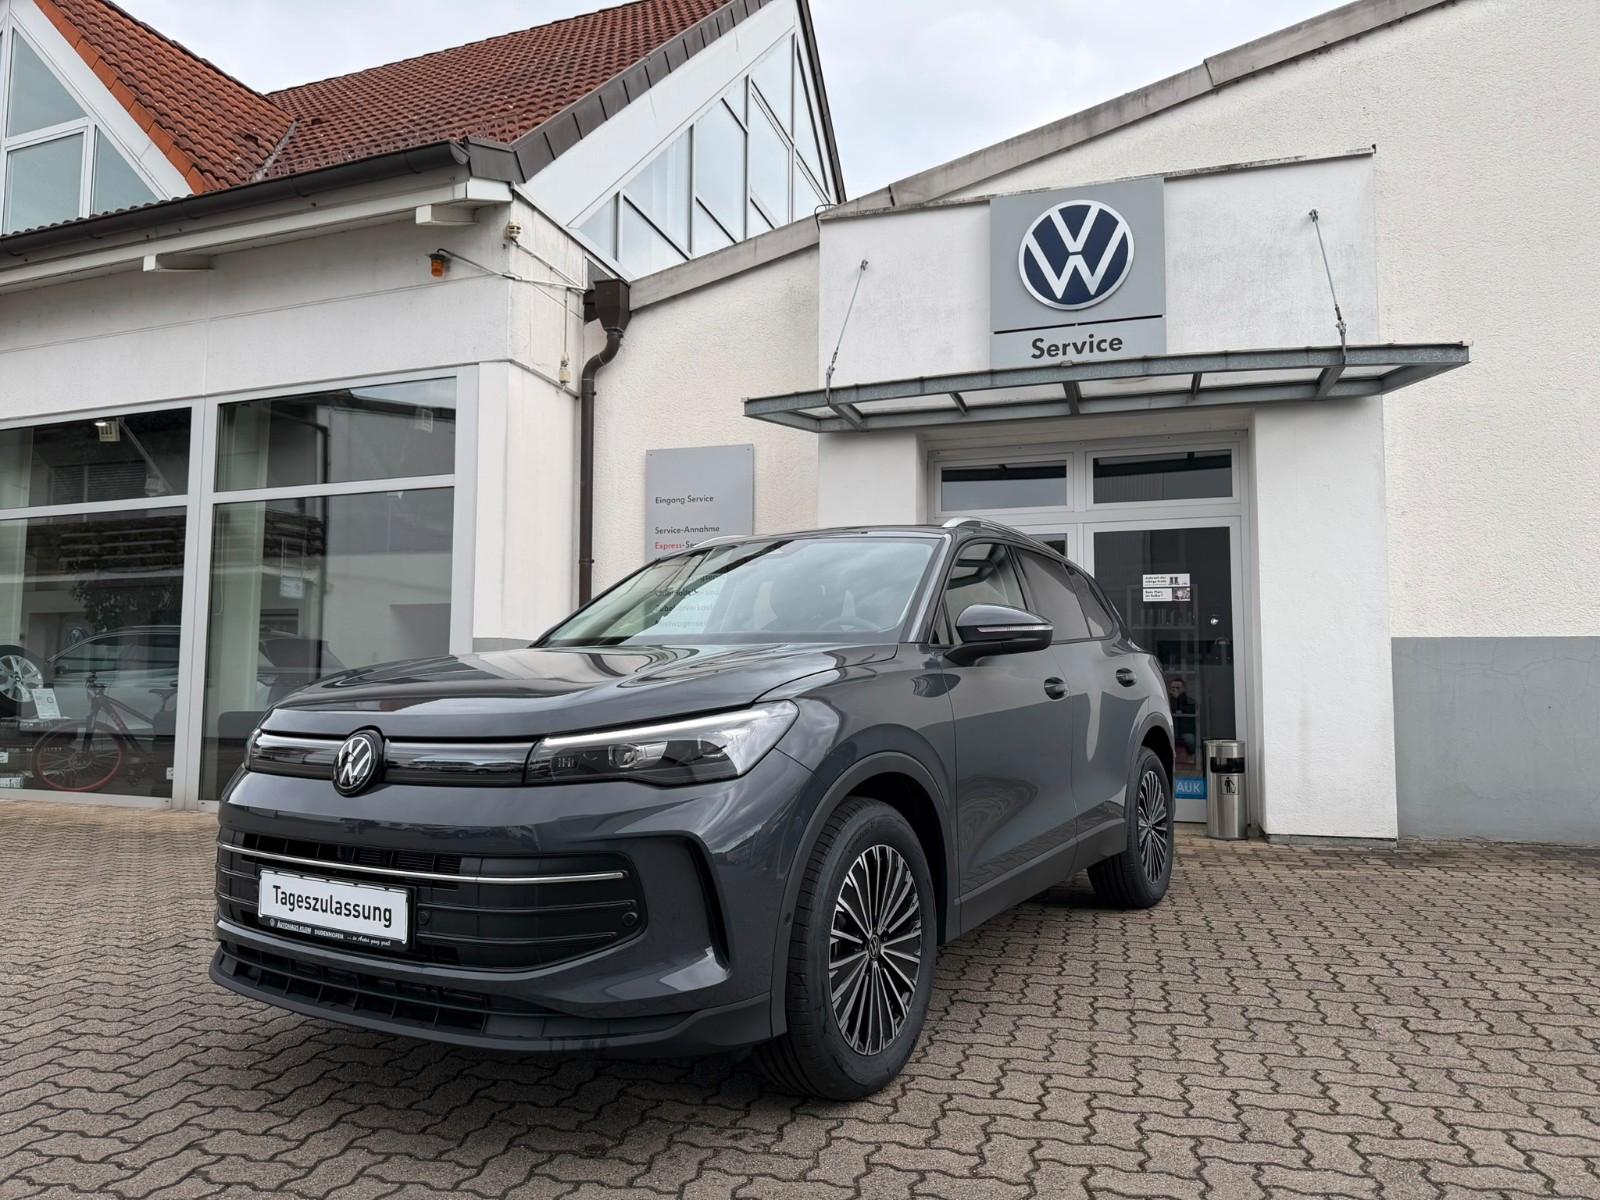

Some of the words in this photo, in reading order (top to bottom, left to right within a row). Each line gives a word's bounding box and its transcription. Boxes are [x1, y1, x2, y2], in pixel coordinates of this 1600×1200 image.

[1031, 334, 1123, 359] Service
[655, 496, 686, 505] Eingang
[687, 494, 715, 503] Service
[655, 524, 721, 535] Service-Annahme
[273, 885, 392, 928] Tageszulassung
